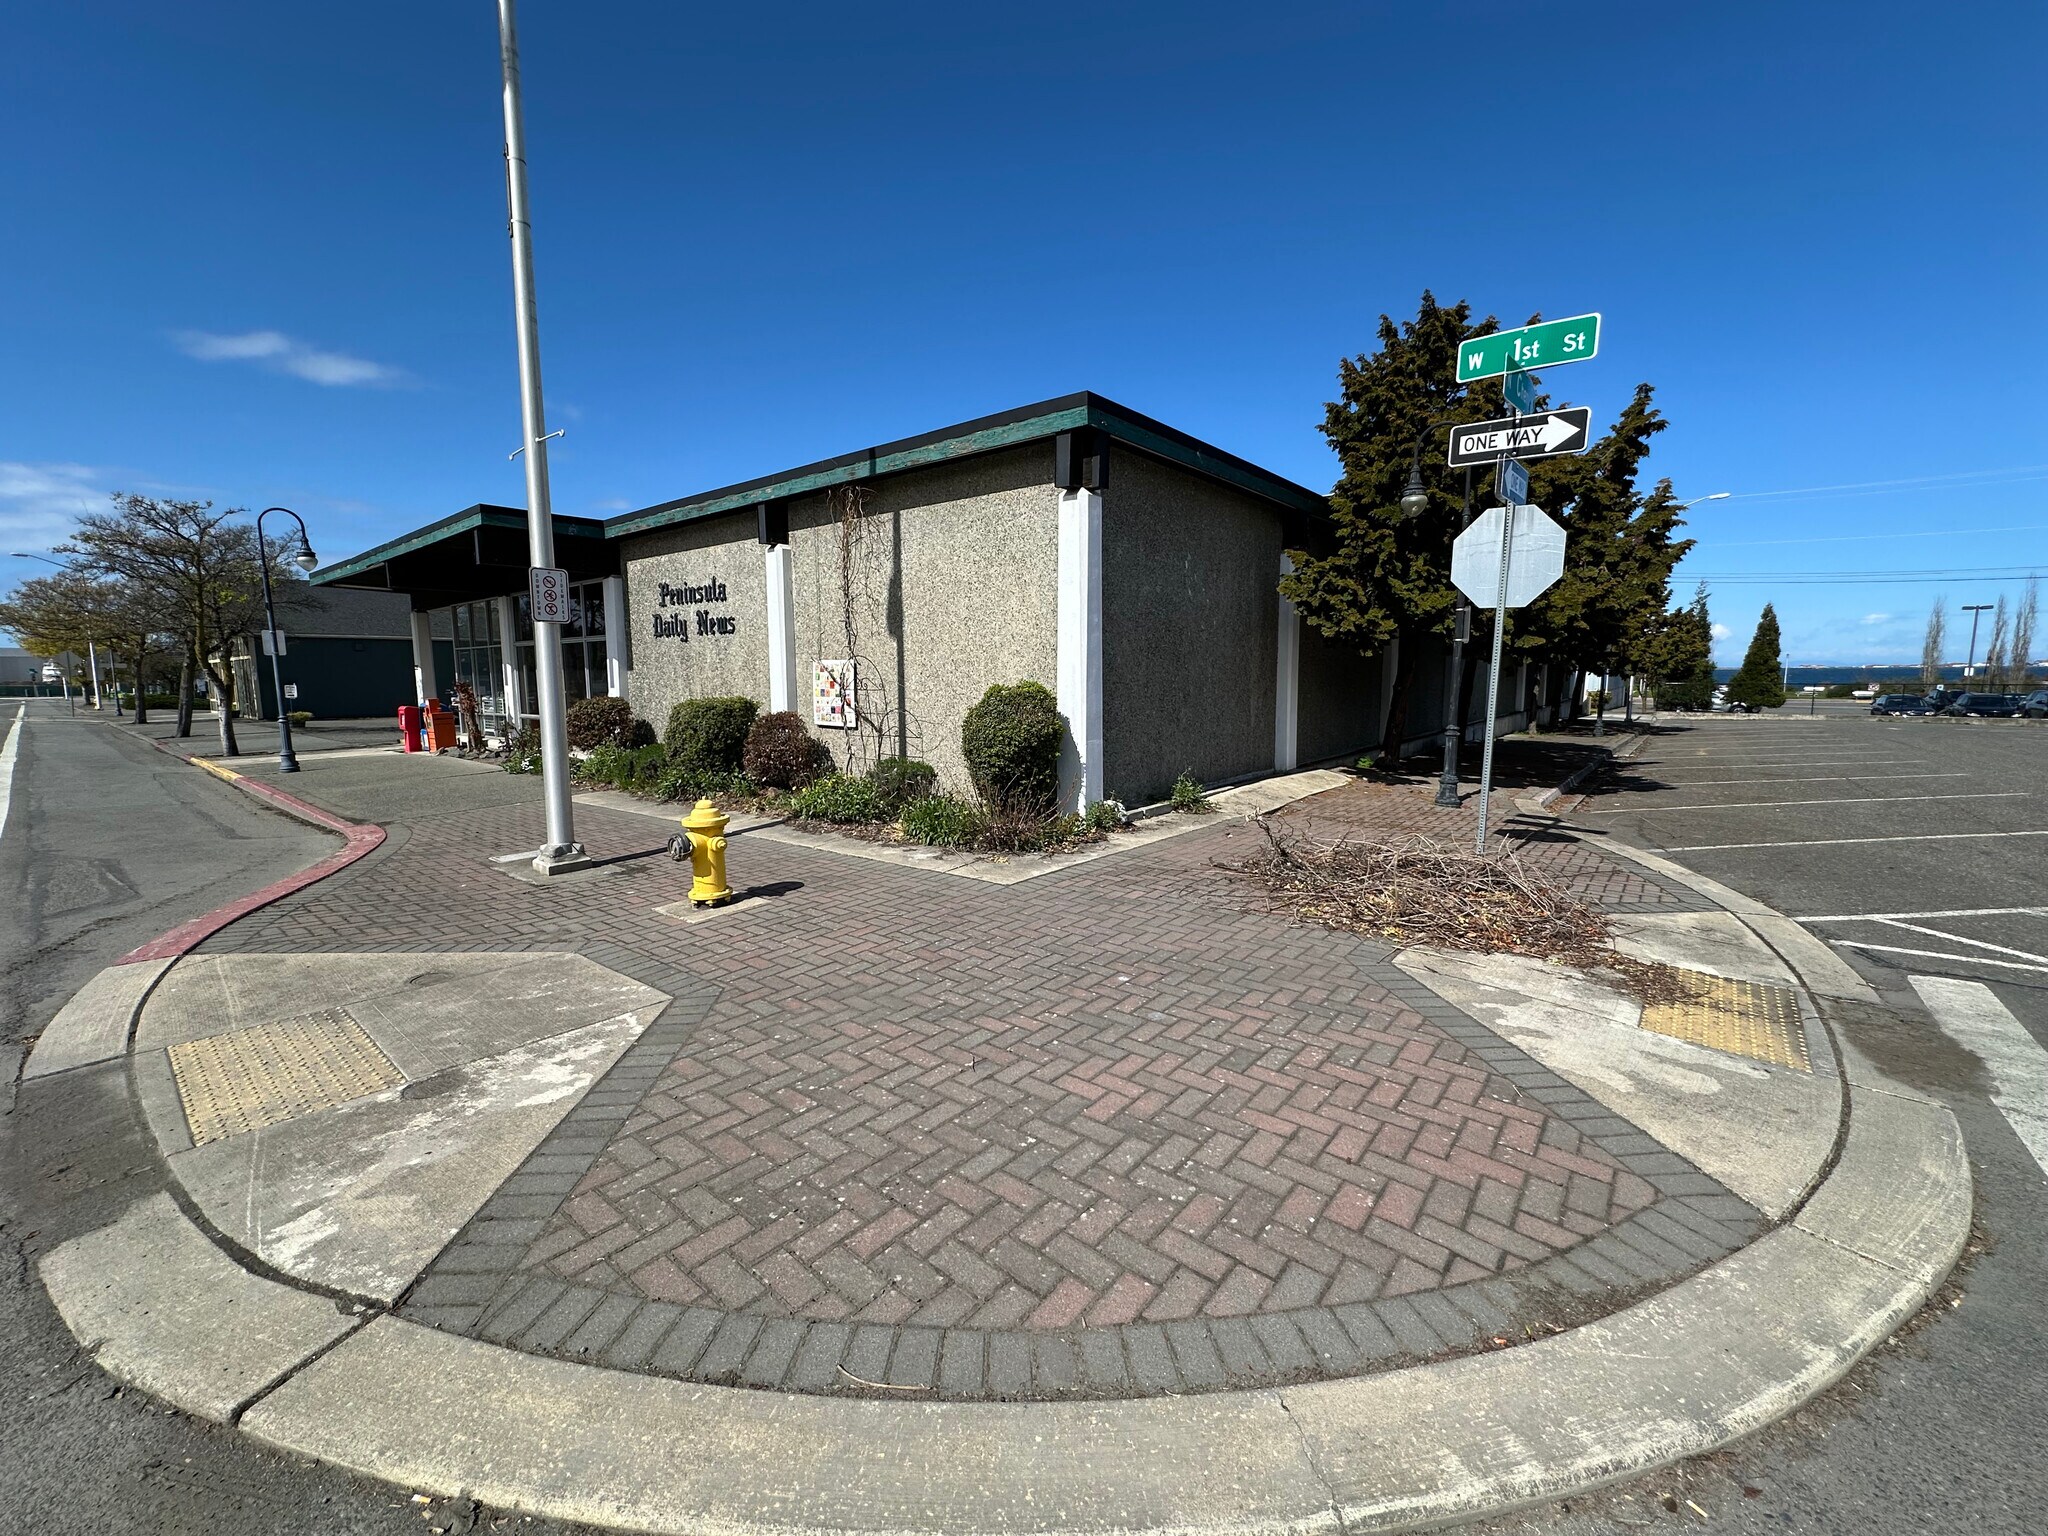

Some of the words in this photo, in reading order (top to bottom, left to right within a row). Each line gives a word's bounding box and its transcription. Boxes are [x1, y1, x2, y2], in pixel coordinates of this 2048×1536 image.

[1468, 351, 1484, 371] W
[1513, 337, 1540, 362] 1st
[1562, 331, 1586, 353] St
[1464, 433, 1498, 452] ONE
[1506, 427, 1544, 447] WAY
[658, 576, 727, 607] Peninsula
[652, 613, 688, 643] Daily
[696, 610, 735, 636] News
